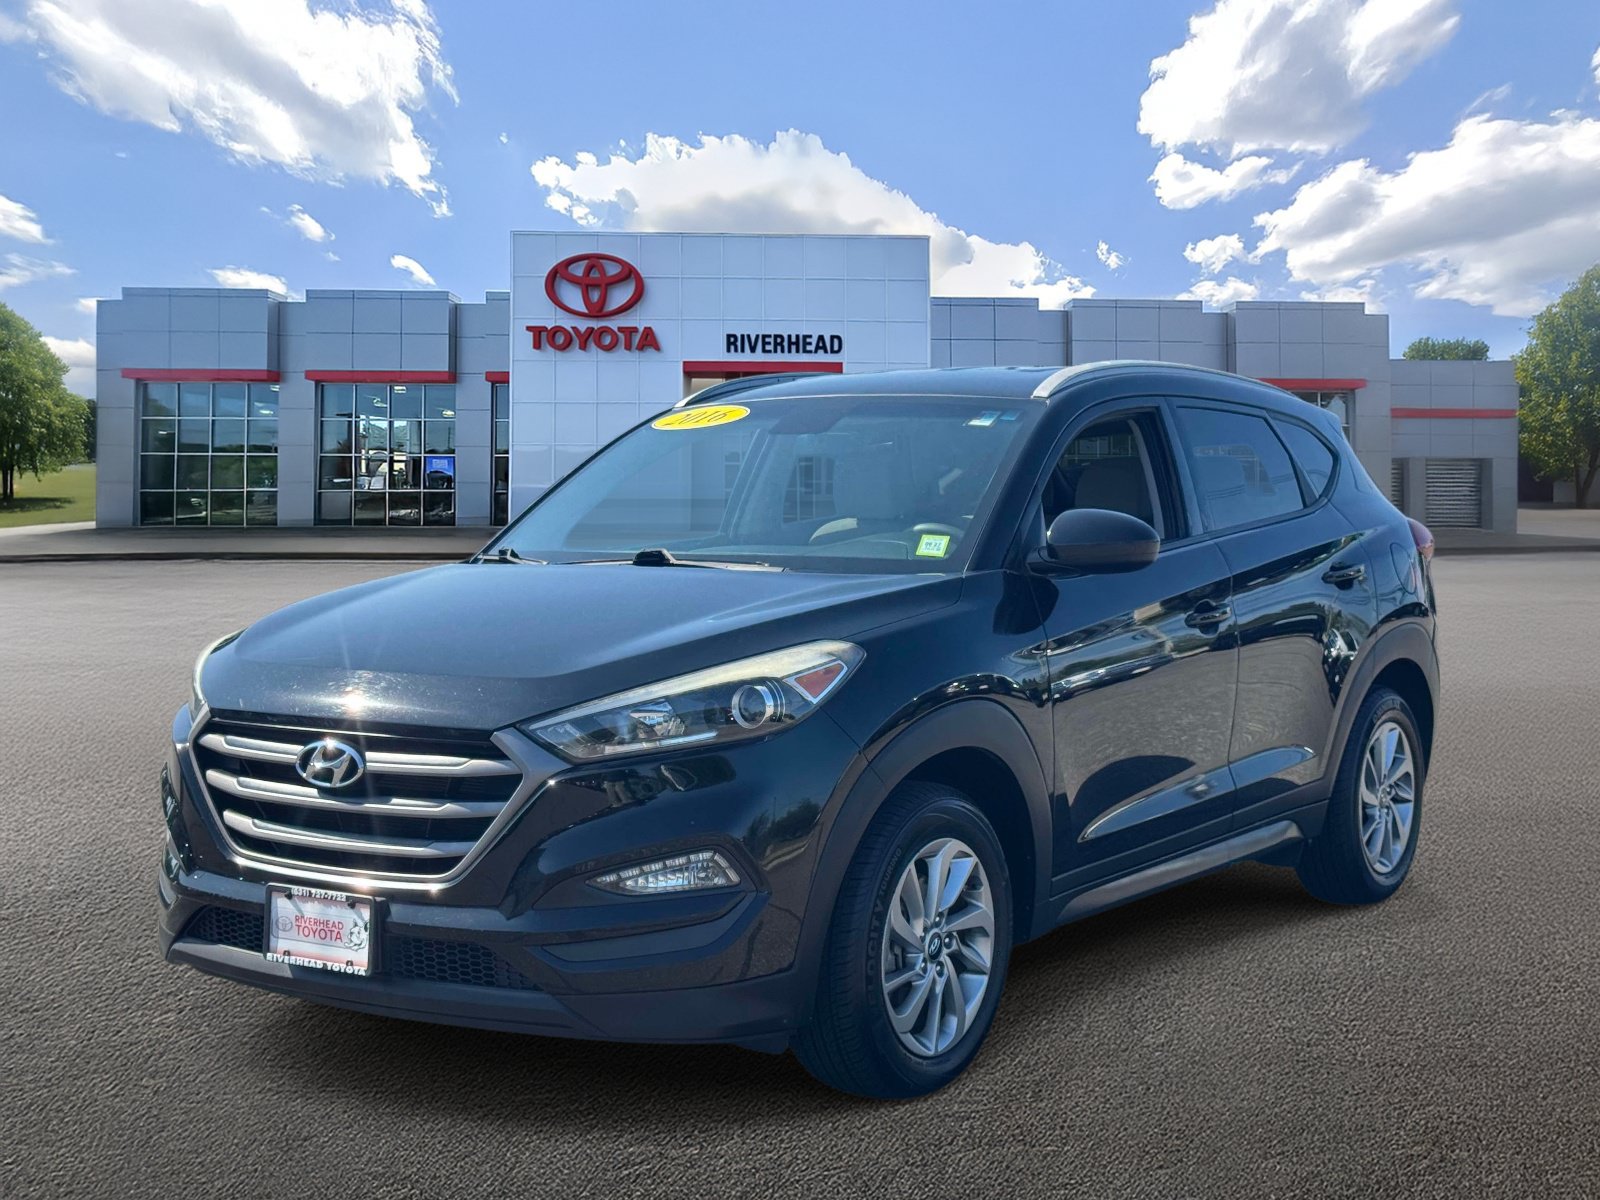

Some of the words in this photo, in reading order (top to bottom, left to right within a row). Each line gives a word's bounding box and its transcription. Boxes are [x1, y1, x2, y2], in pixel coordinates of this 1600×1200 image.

[526, 325, 661, 352] TOYOTA
[726, 333, 843, 354] RIVERHEAD
[662, 409, 737, 427] 2016
[294, 915, 344, 930] RIVERHEAD
[295, 924, 343, 942] TOYOTA
[266, 952, 324, 969] RIVERHEAD
[324, 962, 366, 976] TOYOTA
